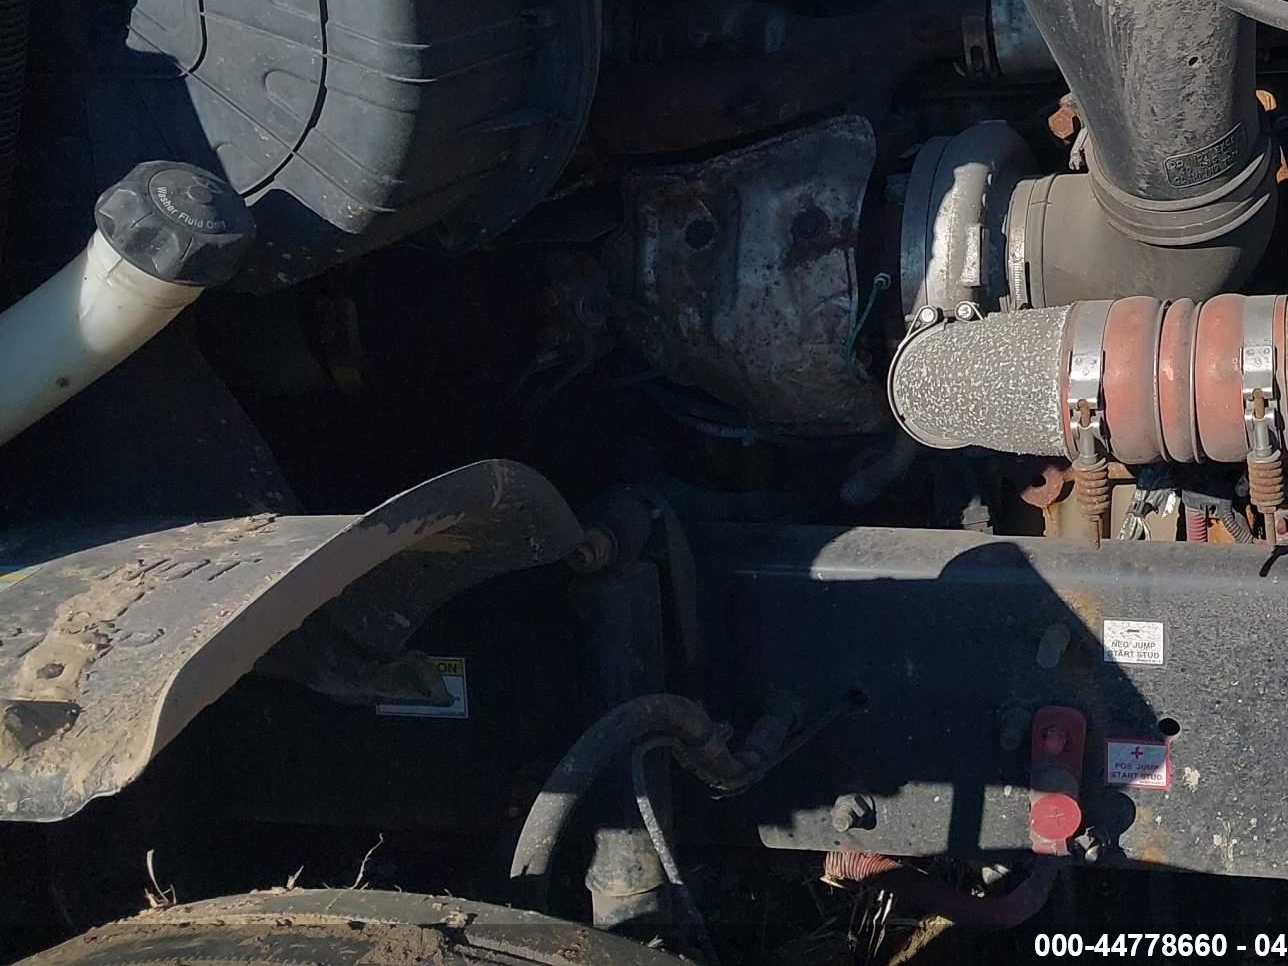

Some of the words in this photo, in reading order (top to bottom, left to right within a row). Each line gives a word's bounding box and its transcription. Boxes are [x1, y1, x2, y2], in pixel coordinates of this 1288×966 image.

[157, 186, 178, 215] Washer
[178, 212, 203, 228] Fluid
[1107, 650, 1133, 658] START
[1136, 763, 1159, 772] JUMP
[1140, 773, 1162, 781] STUD
